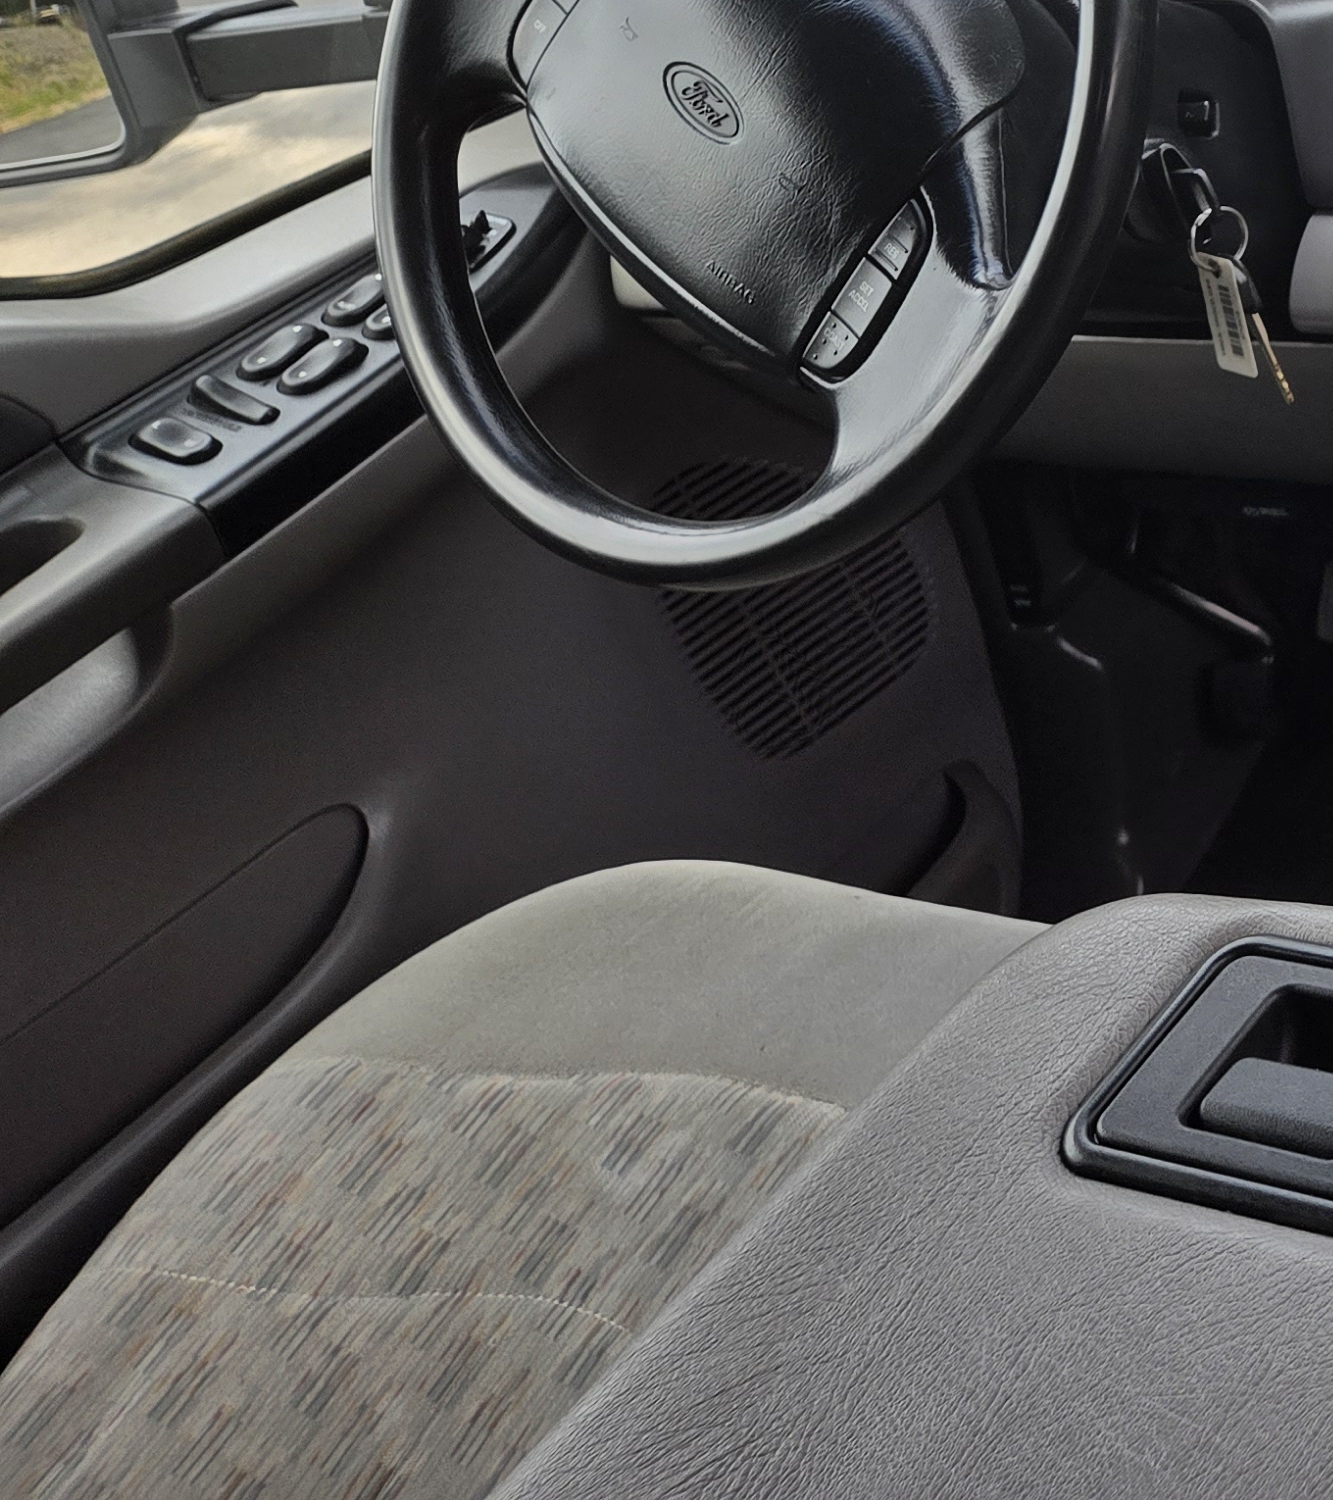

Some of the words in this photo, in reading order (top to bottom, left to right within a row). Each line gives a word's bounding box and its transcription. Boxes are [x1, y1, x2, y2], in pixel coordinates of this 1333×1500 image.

[681, 79, 730, 128] Ford
[885, 242, 901, 260] RES
[705, 260, 757, 305] AIRBAG
[859, 280, 875, 296] SET
[848, 289, 870, 313] ACCEL
[823, 328, 846, 351] COAST
